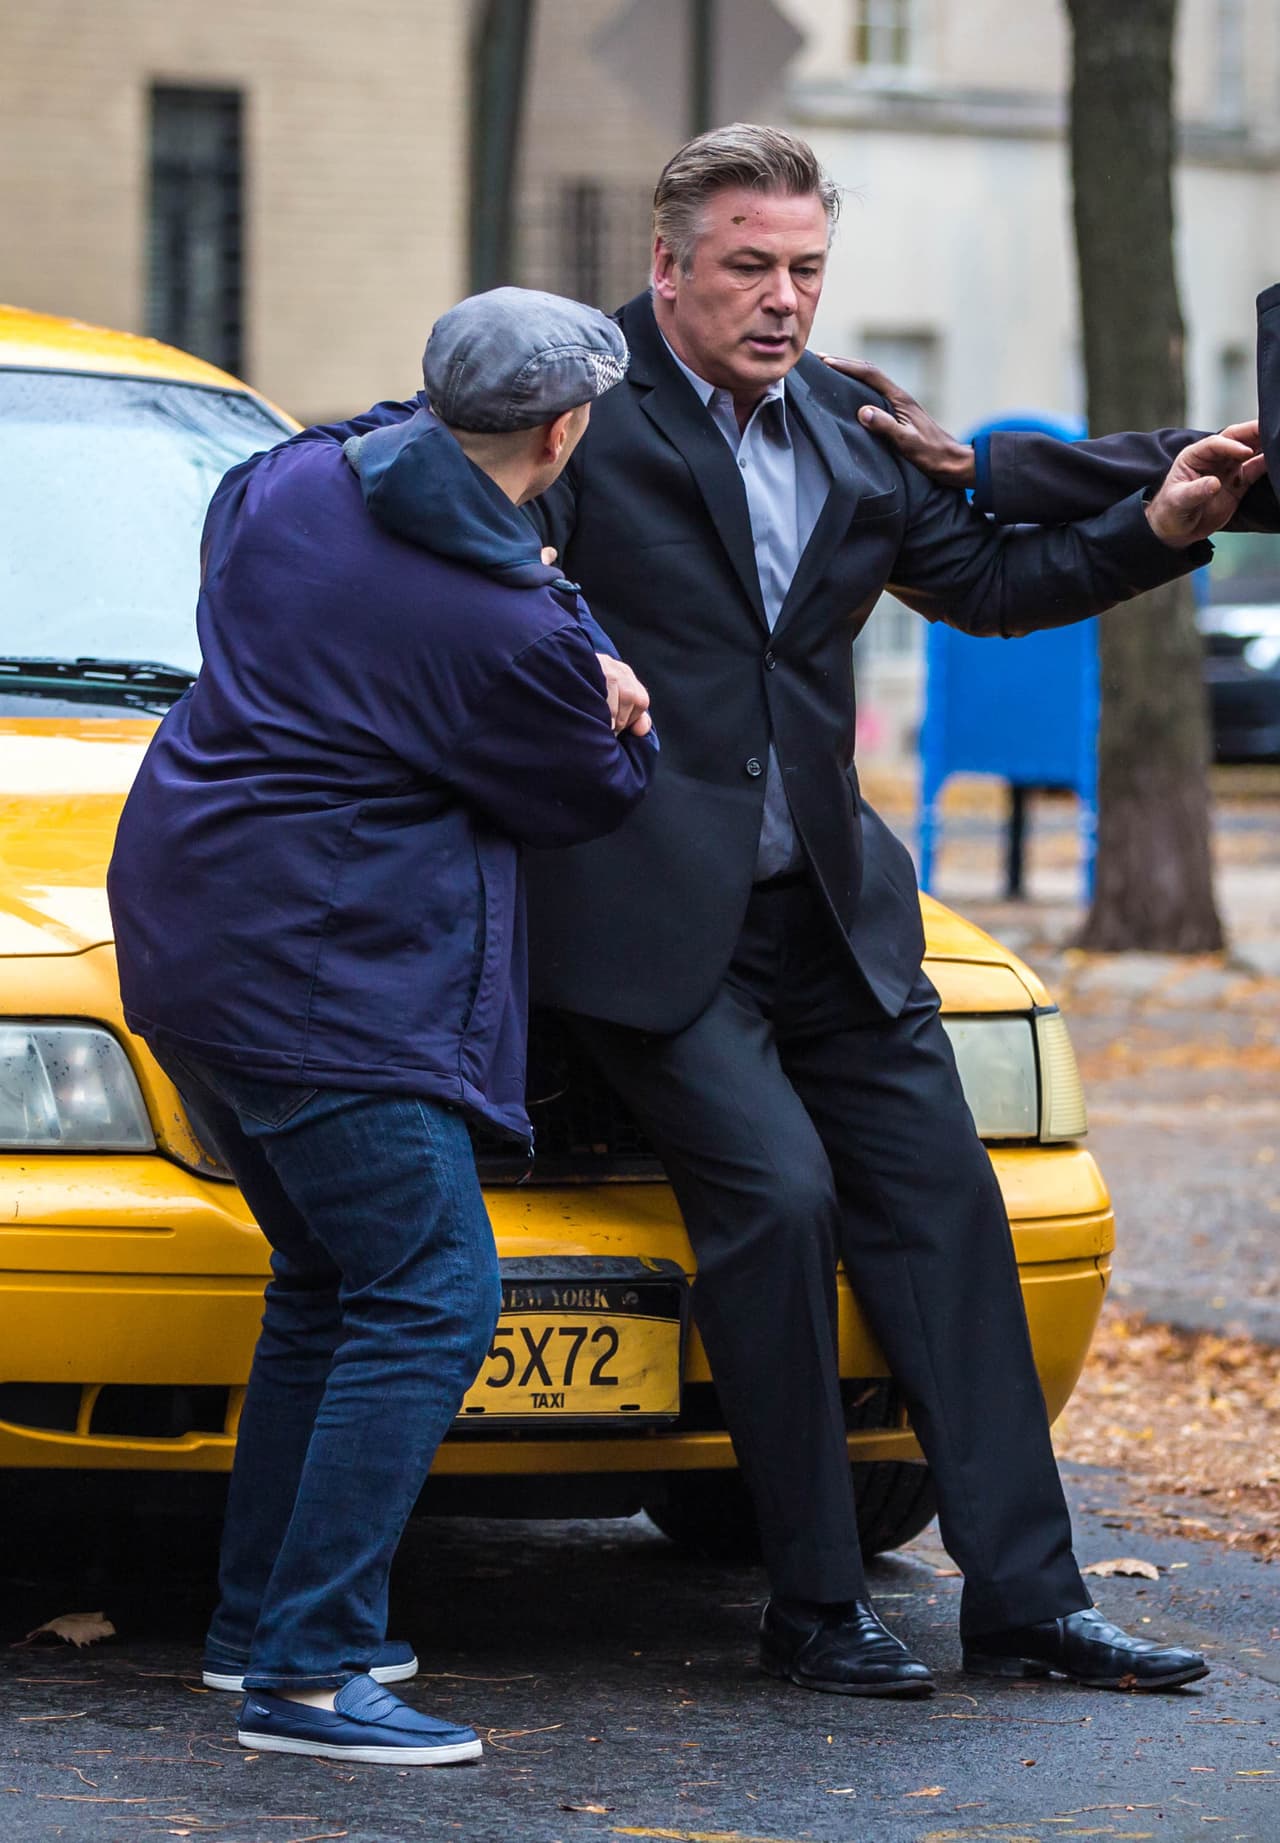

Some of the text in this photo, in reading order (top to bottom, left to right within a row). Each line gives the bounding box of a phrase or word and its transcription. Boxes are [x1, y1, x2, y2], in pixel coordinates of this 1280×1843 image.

[551, 1288, 610, 1309] YORK
[485, 1325, 619, 1388] 5X72
[531, 1392, 565, 1409] TAXI
